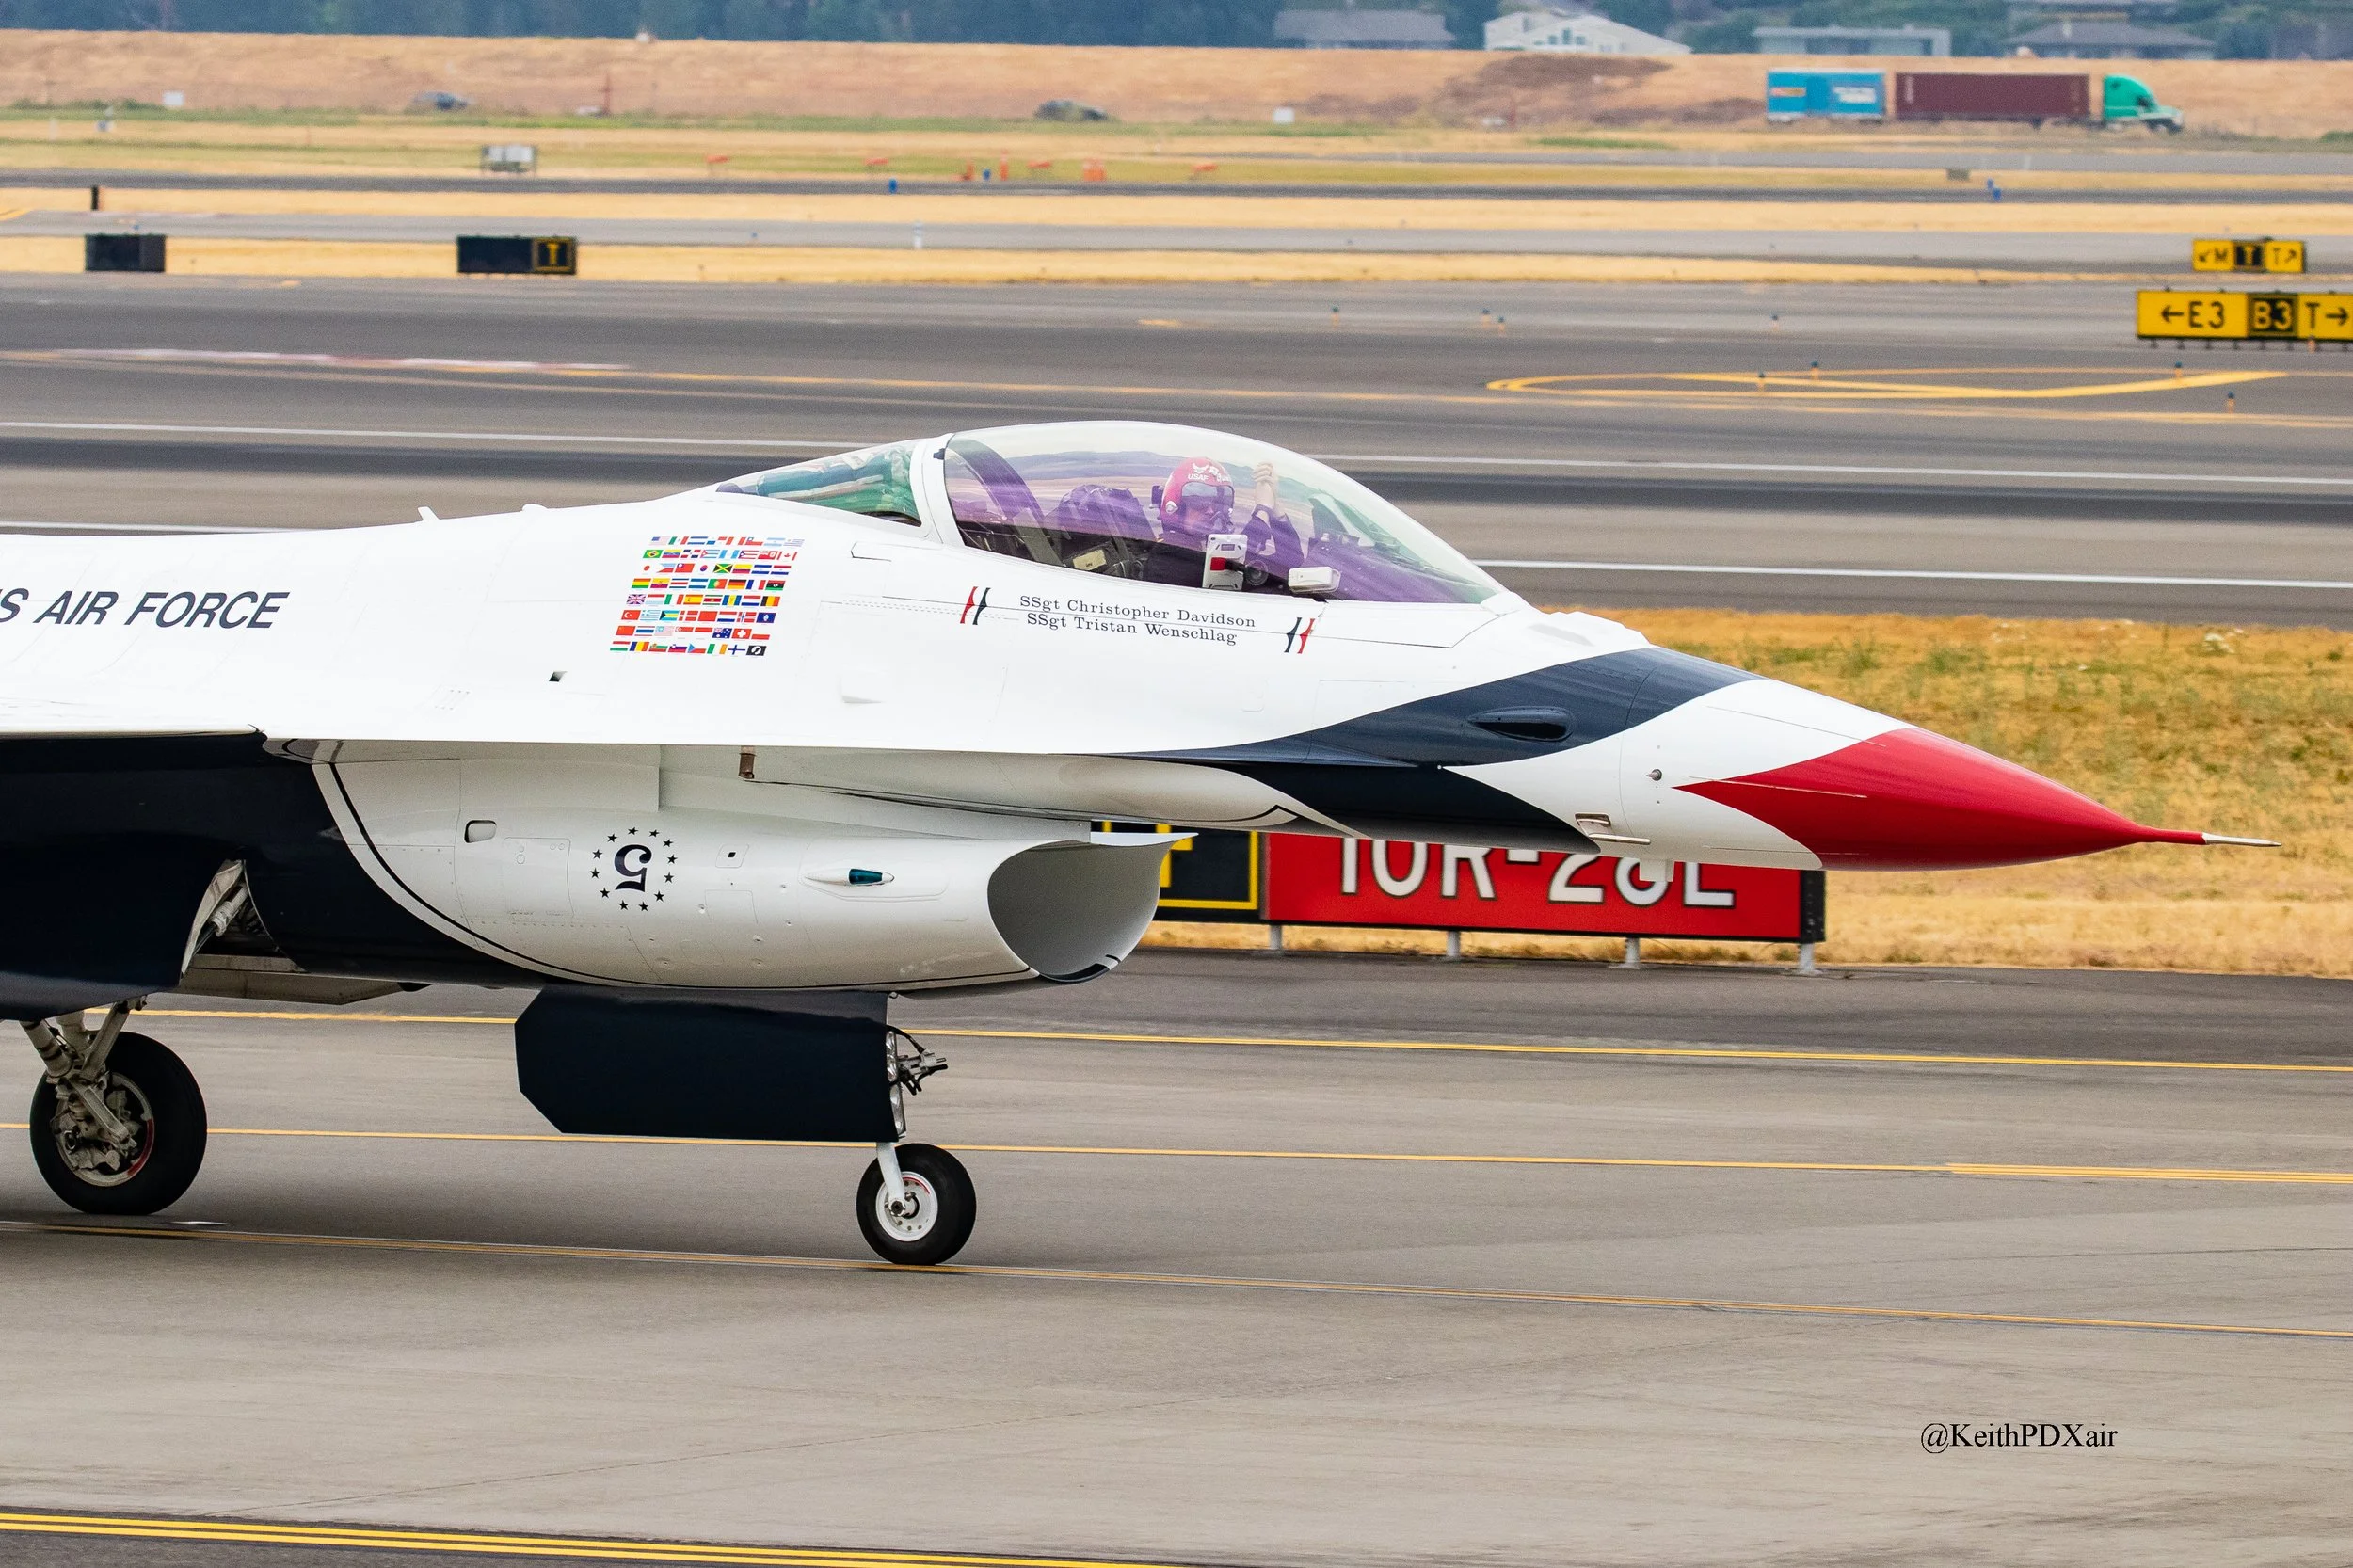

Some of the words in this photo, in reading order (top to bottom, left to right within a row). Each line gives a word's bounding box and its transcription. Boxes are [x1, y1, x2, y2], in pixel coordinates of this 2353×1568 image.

[546, 243, 560, 266] T
[2243, 245, 2256, 265] T
[2273, 248, 2281, 264] T
[2188, 300, 2224, 329] E3
[2253, 300, 2293, 329] B3
[2305, 301, 2320, 329] T
[0, 588, 29, 623] S
[33, 590, 119, 625] AIR
[124, 591, 290, 629] FORCE
[1020, 595, 1060, 612] SSgt
[1067, 600, 1169, 620] Christopher
[1177, 609, 1256, 627] Davidson
[1027, 613, 1066, 631] SSgt
[1074, 616, 1138, 633] Tristan
[1144, 623, 1238, 646] Wenschlag
[614, 844, 652, 892] 5
